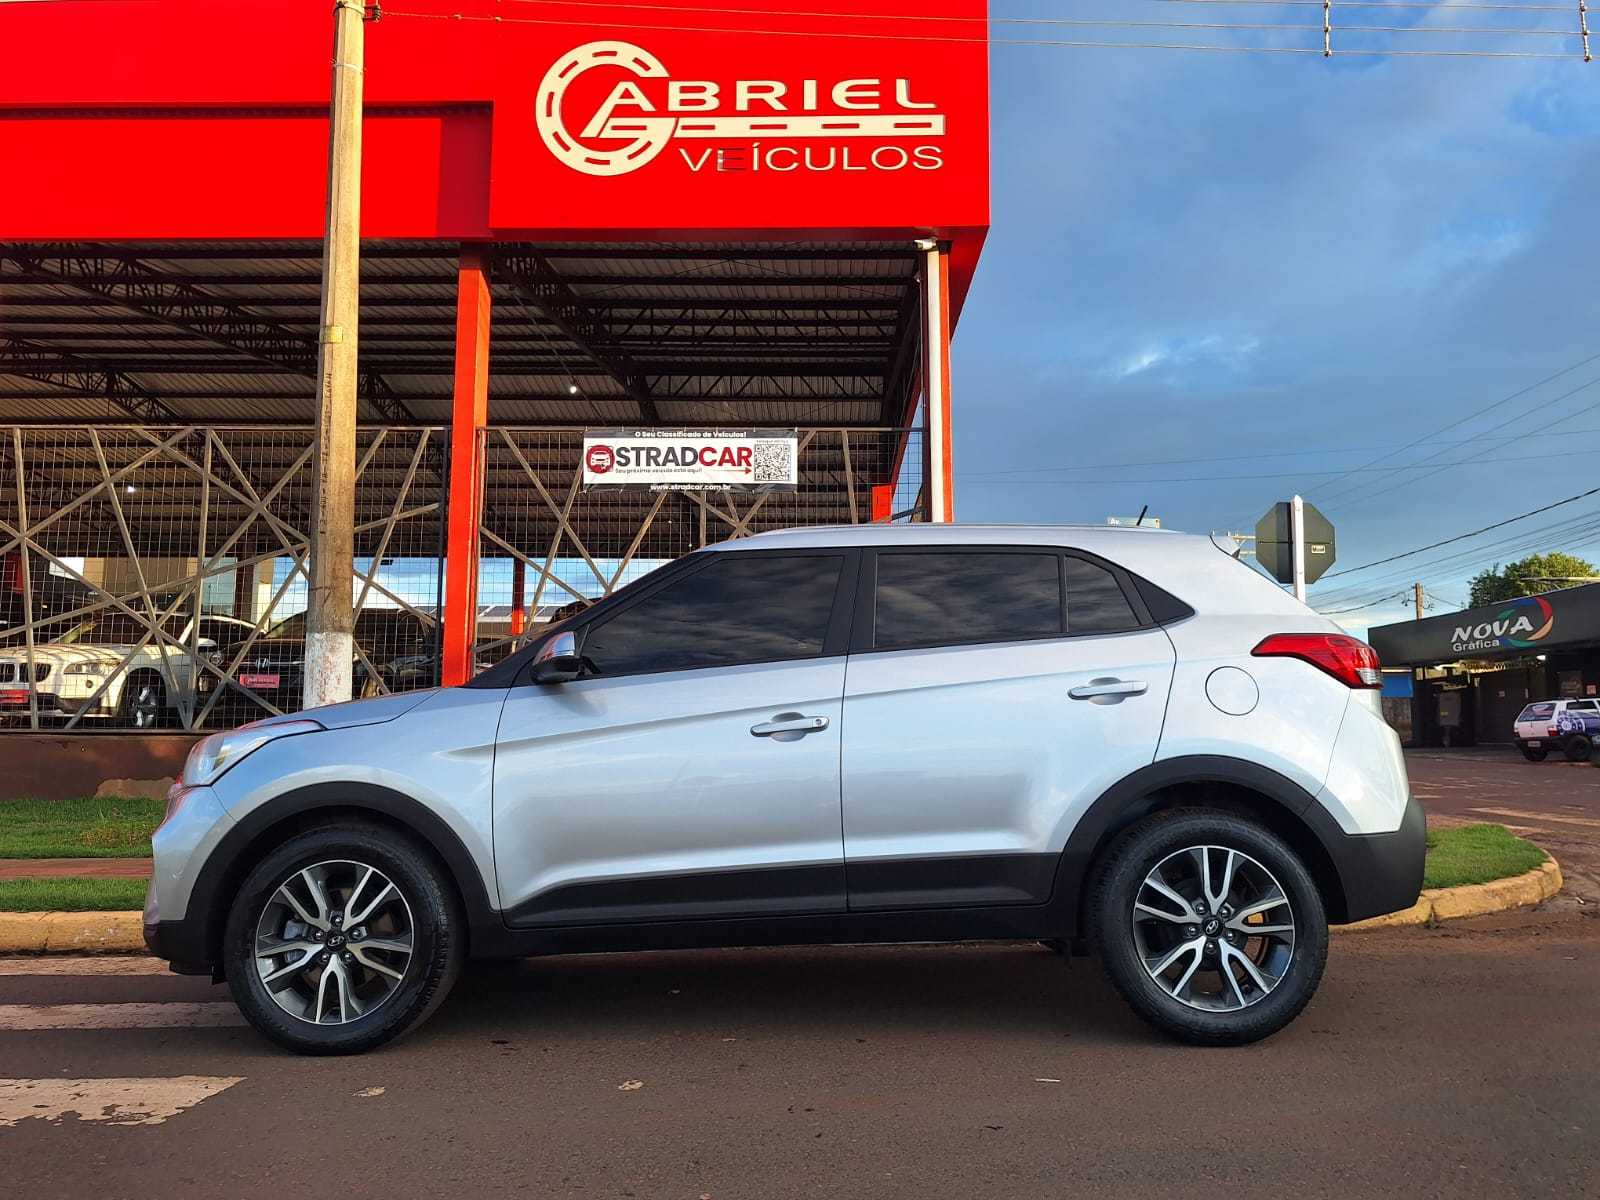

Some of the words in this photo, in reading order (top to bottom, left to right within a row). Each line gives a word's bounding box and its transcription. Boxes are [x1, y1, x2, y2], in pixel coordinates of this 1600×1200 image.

[535, 40, 936, 176] GABRIEL
[657, 430, 701, 438] Classificado
[616, 446, 752, 467] STRADCAR
[1451, 616, 1534, 643] NOVA
